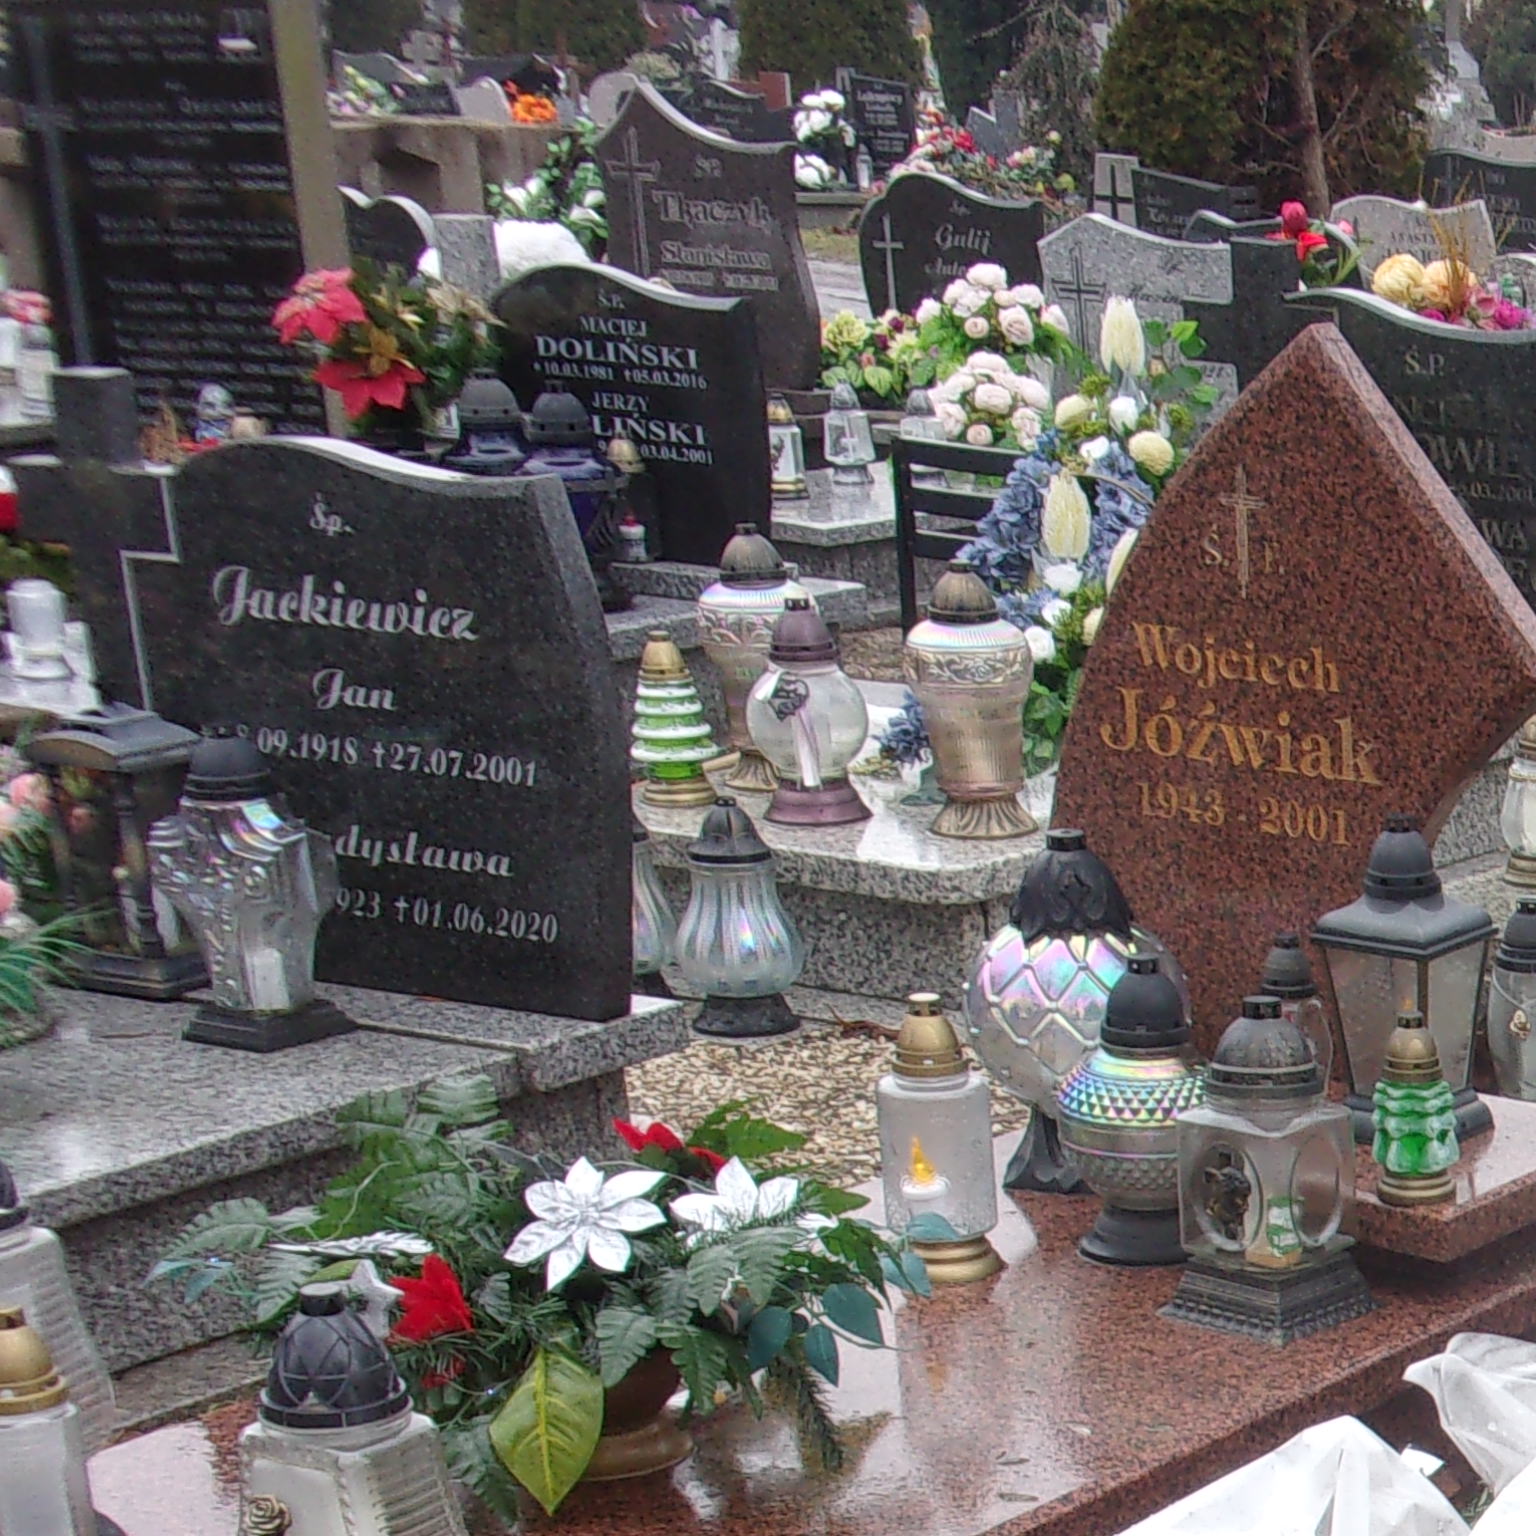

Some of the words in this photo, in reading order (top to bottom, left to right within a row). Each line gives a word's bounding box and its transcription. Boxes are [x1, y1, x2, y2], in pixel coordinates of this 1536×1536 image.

[580, 316, 648, 337] MACIEJ
[535, 335, 700, 370] DOLIŃSKI
[591, 391, 650, 413] JERZY
[591, 412, 707, 447] LIŃSKI
[212, 564, 480, 643] Jackiewicz
[1131, 620, 1342, 694] Wojciech
[312, 667, 399, 713] Jan
[1101, 686, 1384, 788] Jóźwiak
[391, 742, 538, 789] 27.07.2001
[1258, 796, 1353, 848] 2001
[334, 825, 516, 879] dysława
[335, 887, 383, 919] 923
[412, 896, 560, 945] 01.06.2020
